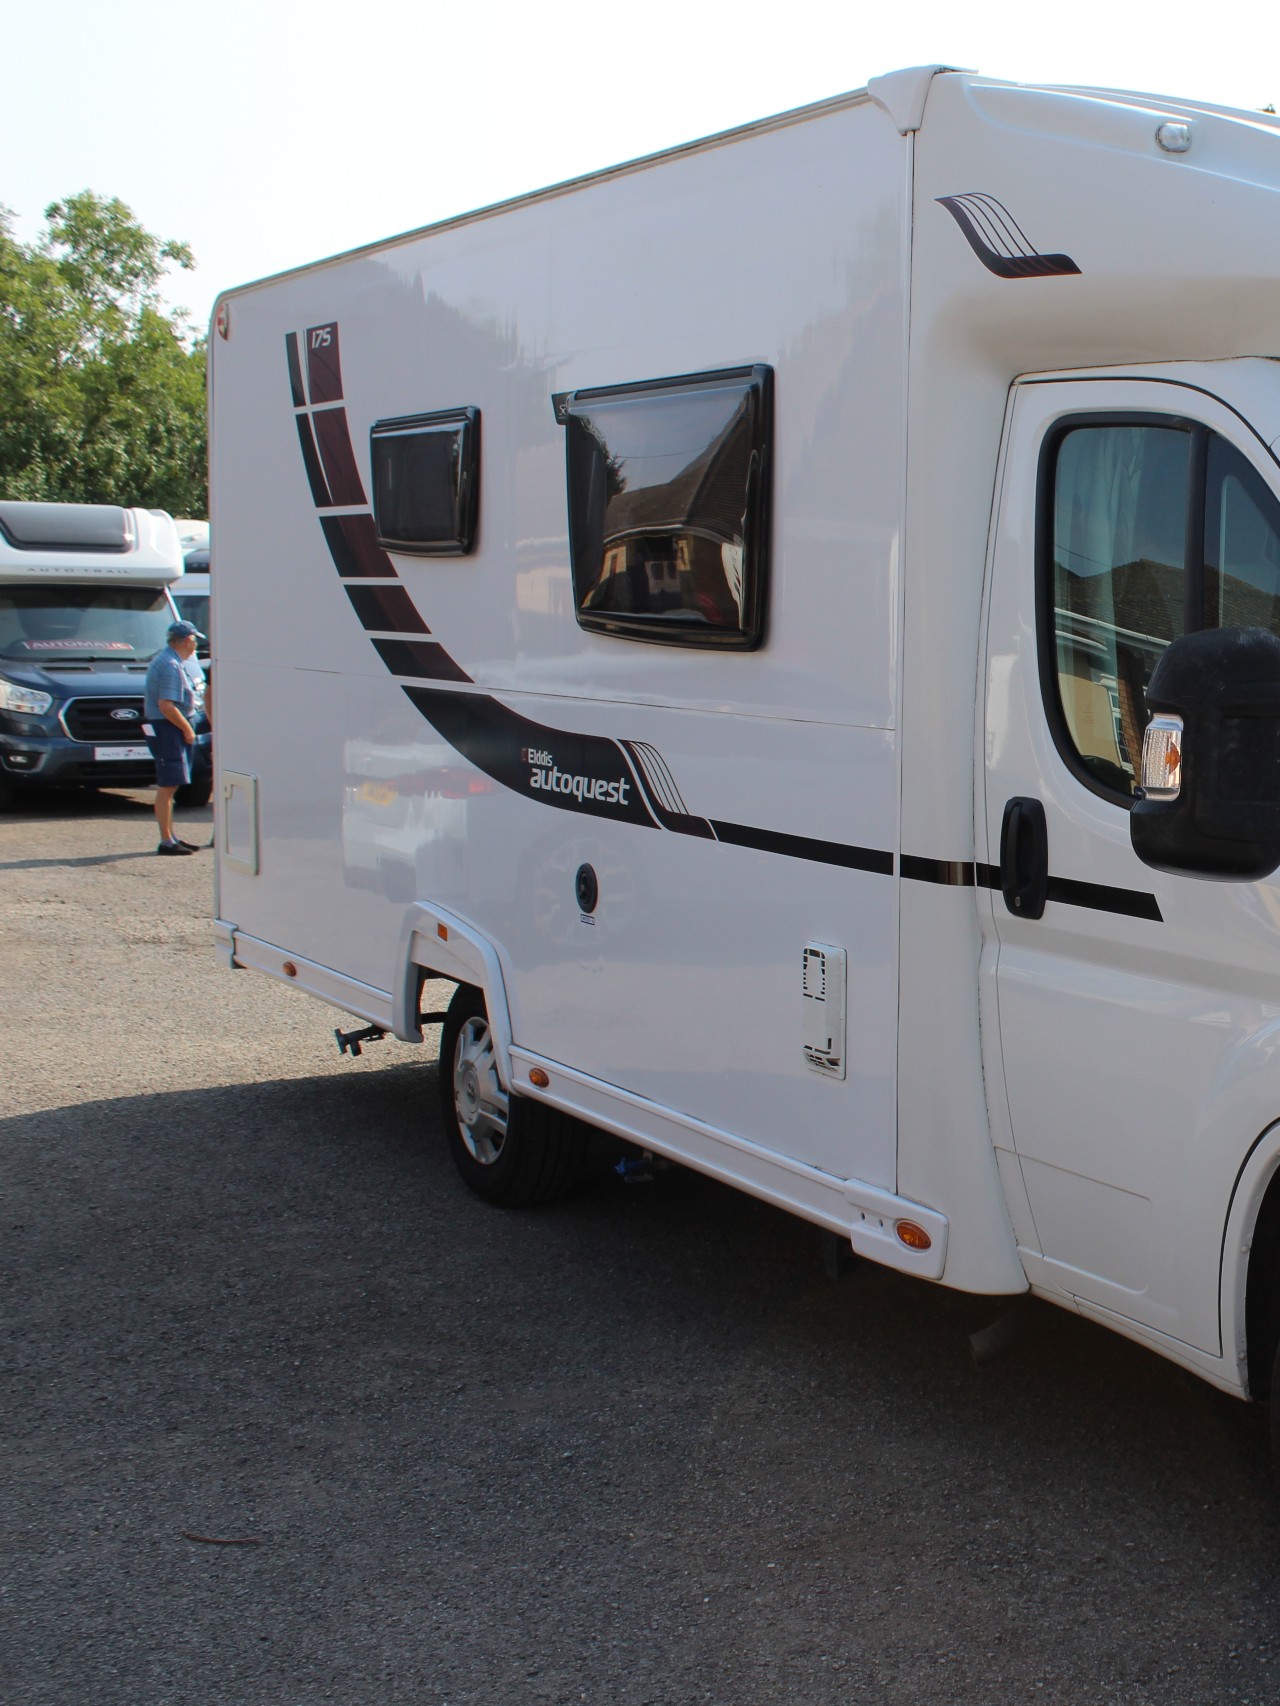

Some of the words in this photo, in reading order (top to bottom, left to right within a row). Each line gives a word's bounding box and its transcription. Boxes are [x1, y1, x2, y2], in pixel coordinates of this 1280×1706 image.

[311, 328, 331, 349] 175
[32, 640, 129, 649] AUTOMATIC
[527, 748, 553, 767] Elddis
[529, 765, 631, 806] autoquest
